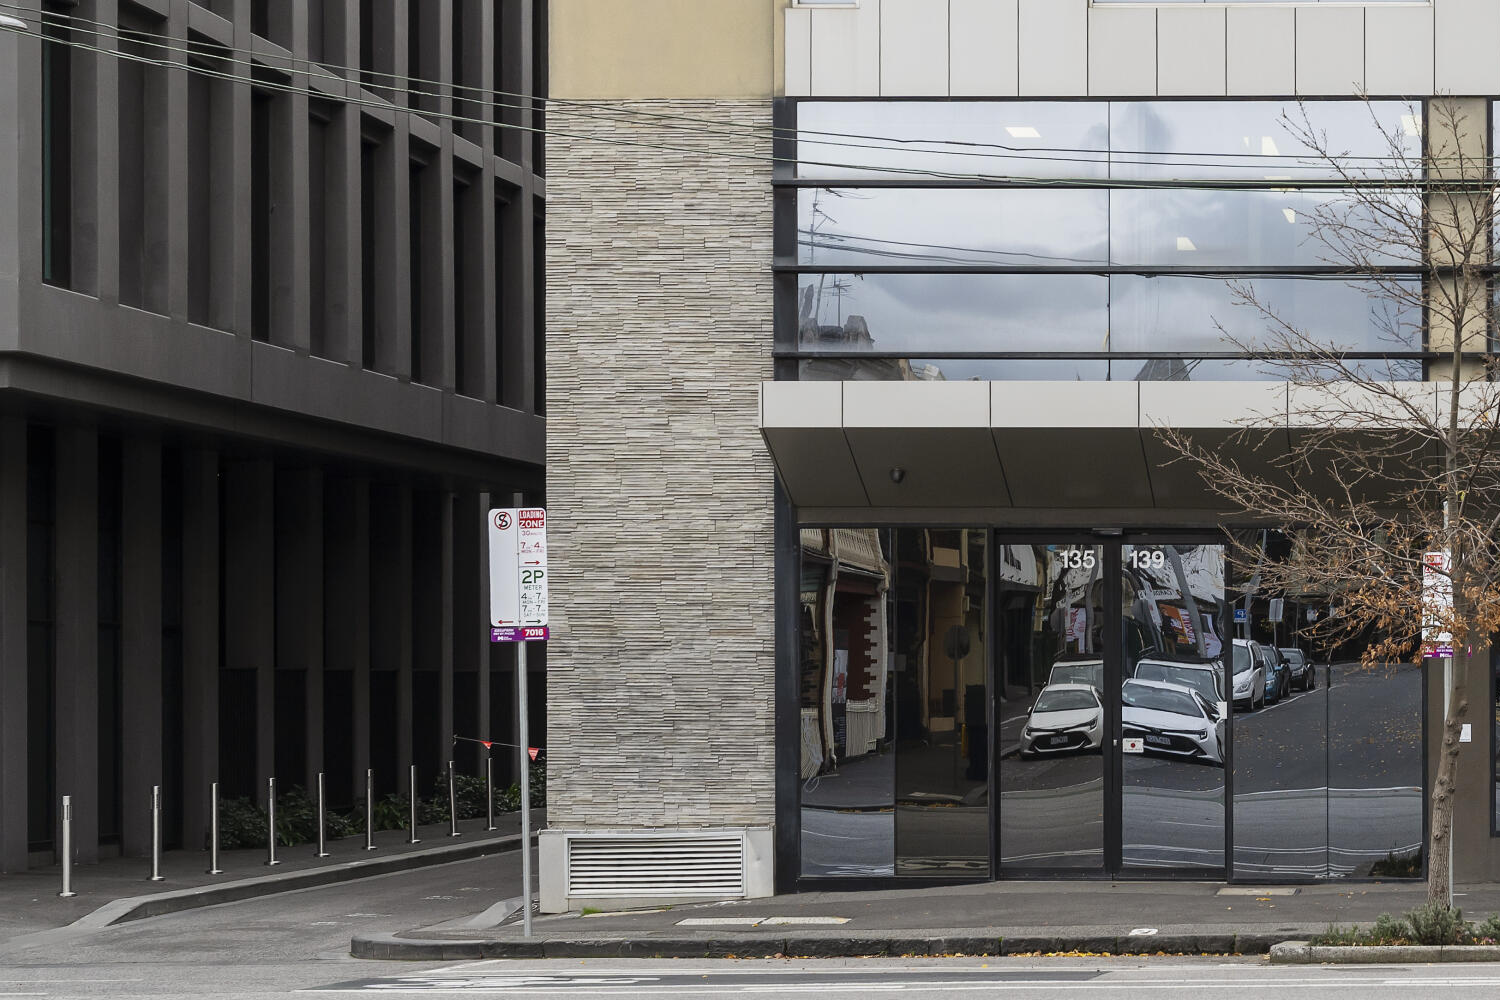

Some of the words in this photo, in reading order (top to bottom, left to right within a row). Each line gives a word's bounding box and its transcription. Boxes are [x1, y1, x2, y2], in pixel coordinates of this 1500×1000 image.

[519, 510, 544, 519] LOADING
[519, 519, 544, 528] ZONE
[1059, 549, 1096, 569] 135
[1129, 550, 1165, 569] 139
[522, 570, 544, 584] 2P
